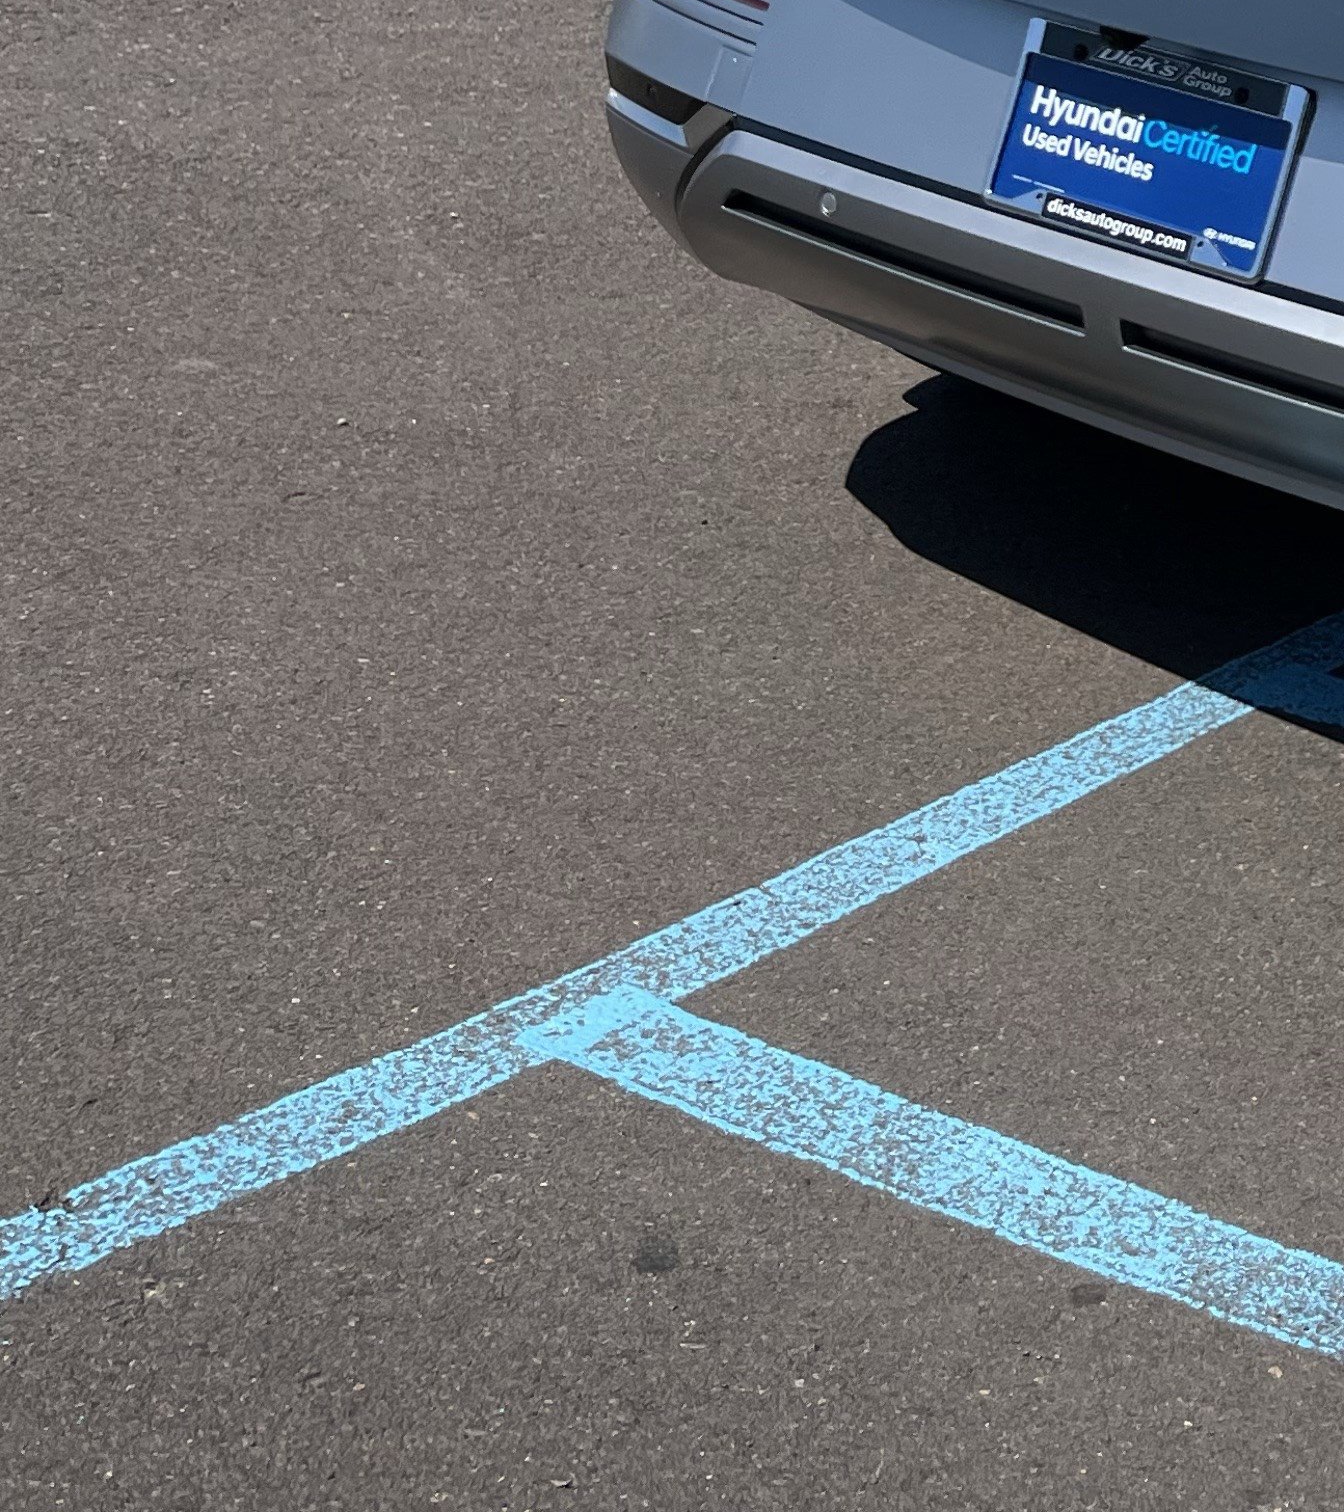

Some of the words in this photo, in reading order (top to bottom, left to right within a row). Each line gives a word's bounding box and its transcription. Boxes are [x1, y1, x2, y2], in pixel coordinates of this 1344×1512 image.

[1183, 75, 1232, 97] Group
[1187, 65, 1229, 84] Auto
[1022, 123, 1073, 157] Used
[1072, 137, 1155, 181] Vehicles
[1030, 84, 1146, 144] Hyundai
[1143, 119, 1258, 175] Certified
[1046, 197, 1188, 252] dicksautogroup.com
